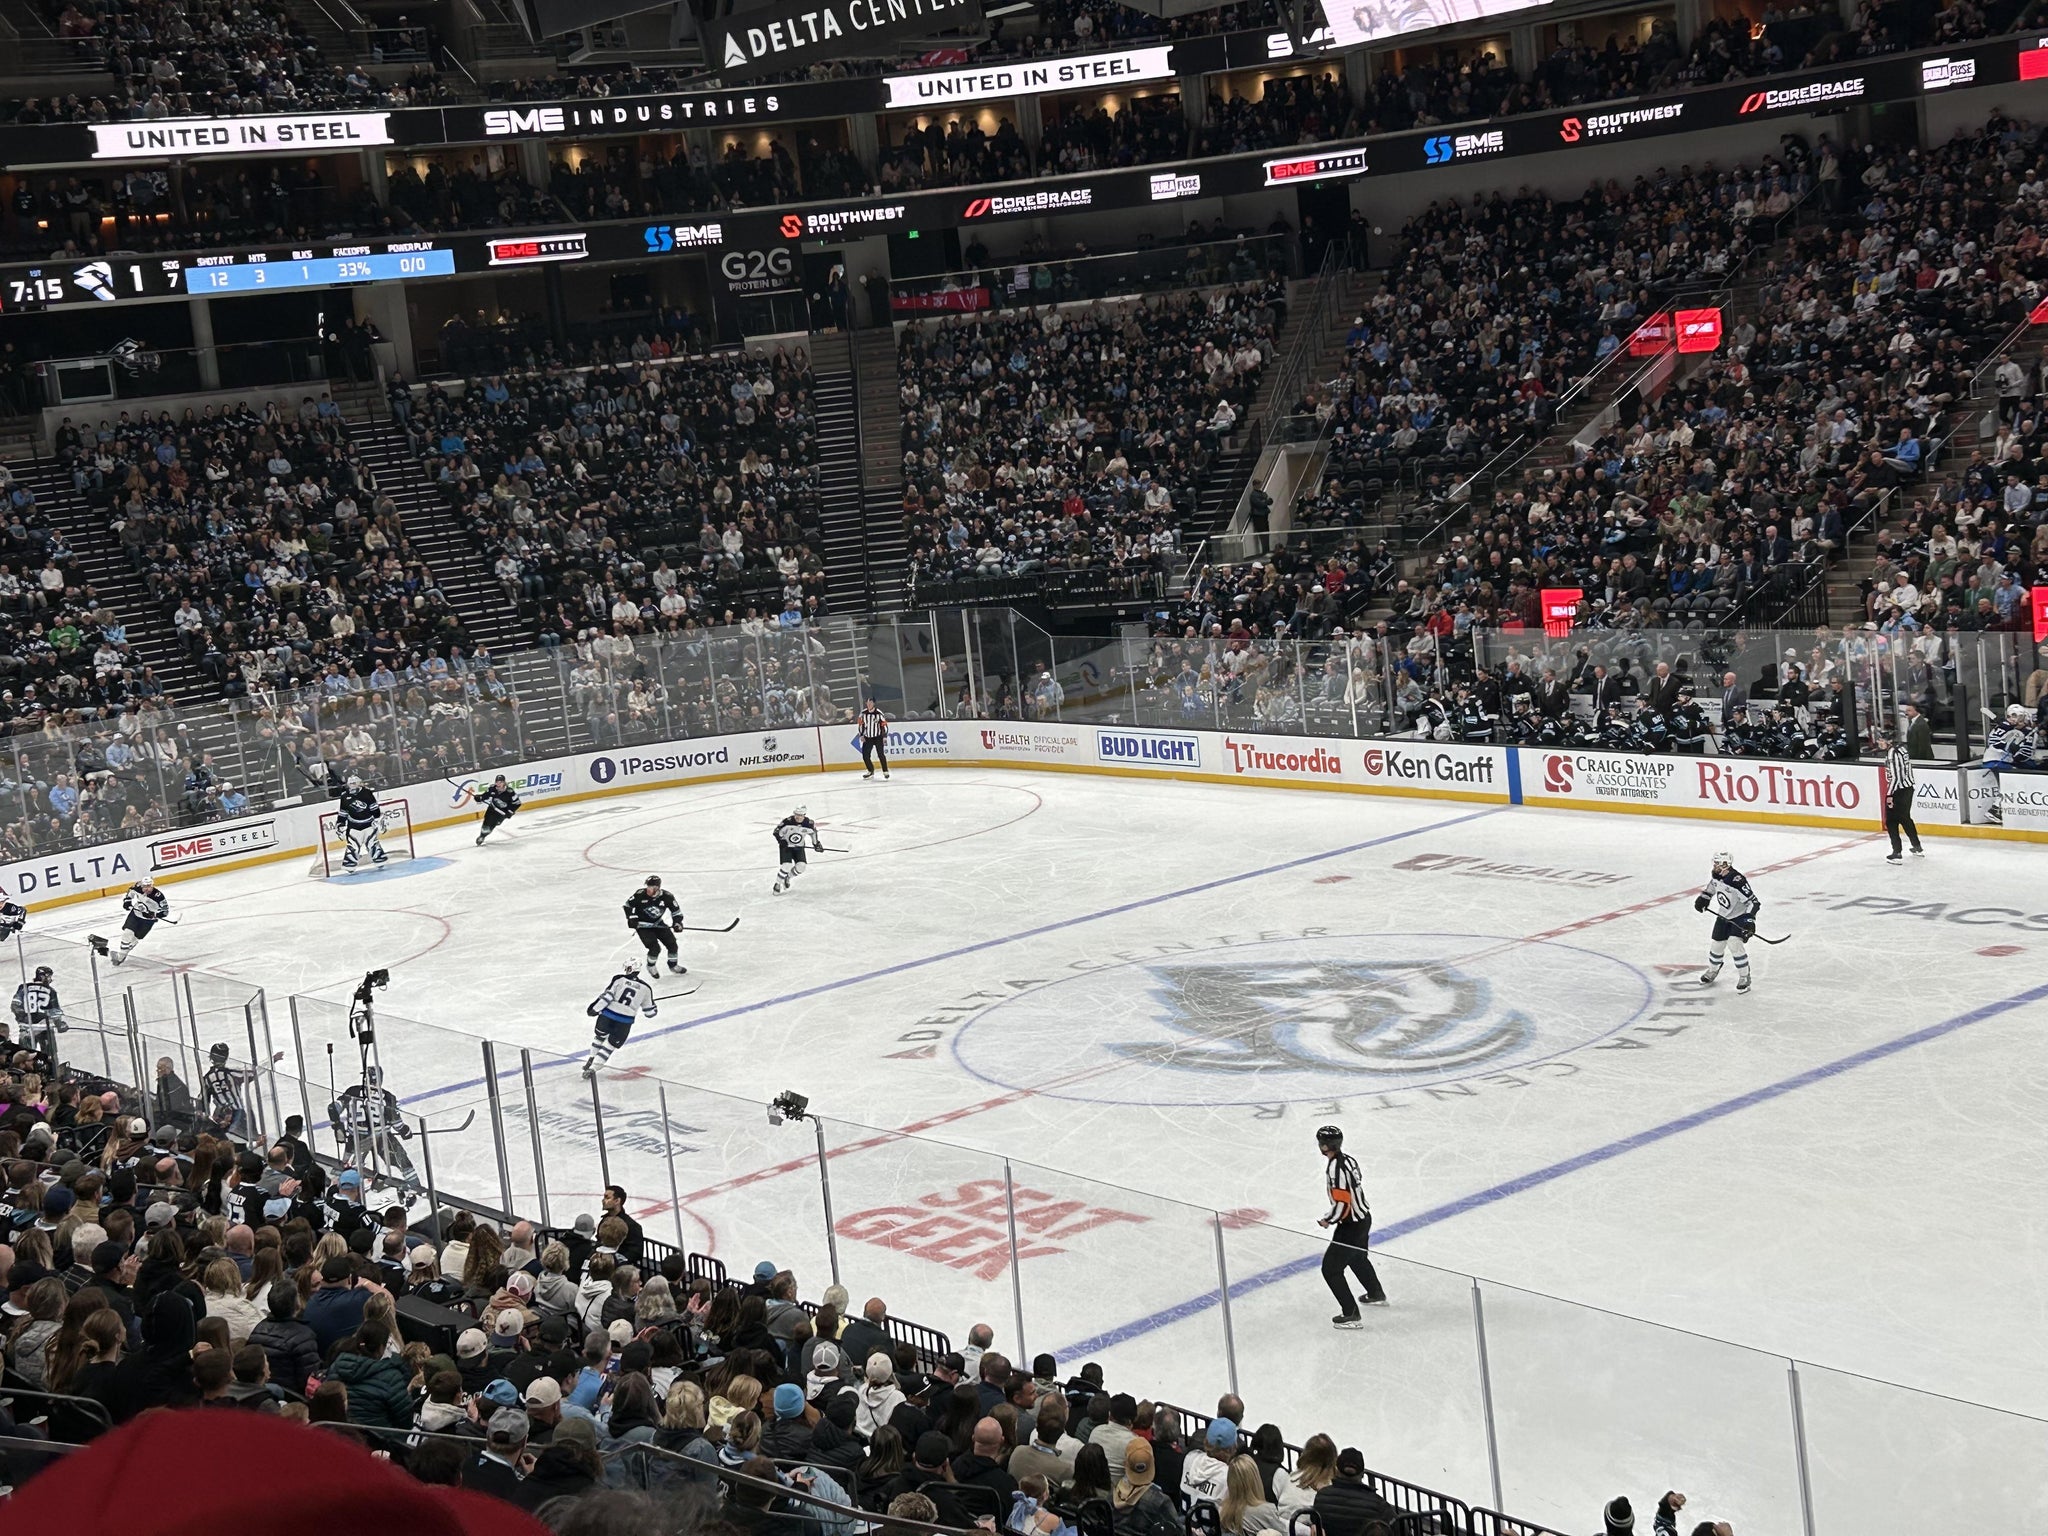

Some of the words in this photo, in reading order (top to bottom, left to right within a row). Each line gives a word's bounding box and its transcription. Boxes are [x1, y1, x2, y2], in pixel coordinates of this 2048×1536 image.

[747, 8, 843, 58] DELTA
[918, 73, 1013, 97] UNITED
[1023, 68, 1048, 86] IN
[1058, 58, 1141, 82] STEEL
[484, 107, 566, 135] SME
[573, 96, 780, 126] INDUSTRIES
[1587, 103, 1684, 129] SOUTHWEST
[126, 126, 230, 149] UNITED
[240, 125, 267, 144] IN
[276, 121, 361, 142] STEEL
[1455, 131, 1503, 150] SME
[1273, 160, 1316, 178] SME
[1318, 156, 1361, 170] STEEL
[807, 205, 905, 227] SOUTHWEST
[674, 224, 722, 241] SME
[497, 243, 538, 257] SME
[540, 242, 581, 252] STEEL
[301, 265, 308, 280] 1
[337, 261, 372, 277] 33%
[400, 257, 425, 273] 0/0
[721, 247, 792, 280] G2G
[129, 265, 144, 292] 1
[167, 272, 178, 288] 7
[209, 271, 228, 287] 12
[254, 269, 265, 284] 3
[729, 279, 769, 291] PROTEIN
[10, 278, 63, 302] 7:15
[909, 746, 950, 754] CONTROL
[998, 734, 1030, 745] HEALTH
[1101, 736, 1139, 758] BUD
[1142, 738, 1196, 762] LIGHT
[620, 746, 730, 777] 1Password
[1242, 743, 1341, 774] Trucordia
[1386, 750, 1431, 779] Ken
[1435, 753, 1493, 783] Garff
[1576, 756, 1622, 774] CRAIG
[1625, 758, 1675, 777] SWAPP
[1586, 773, 1594, 785] &
[1596, 774, 1667, 789] ASSOCIATES
[2017, 792, 2029, 806] &
[160, 838, 213, 861] SME
[219, 829, 269, 846] STEEL
[18, 853, 131, 894] DELTA
[1466, 862, 1633, 884] HEALTH
[898, 978, 1049, 1042] DELTA
[1066, 926, 1329, 970] CENTER
[618, 987, 636, 1006] 6
[1252, 1062, 1580, 1120] CENTER
[918, 1178, 1153, 1240] SEAT
[834, 1206, 1069, 1282] GEEK
